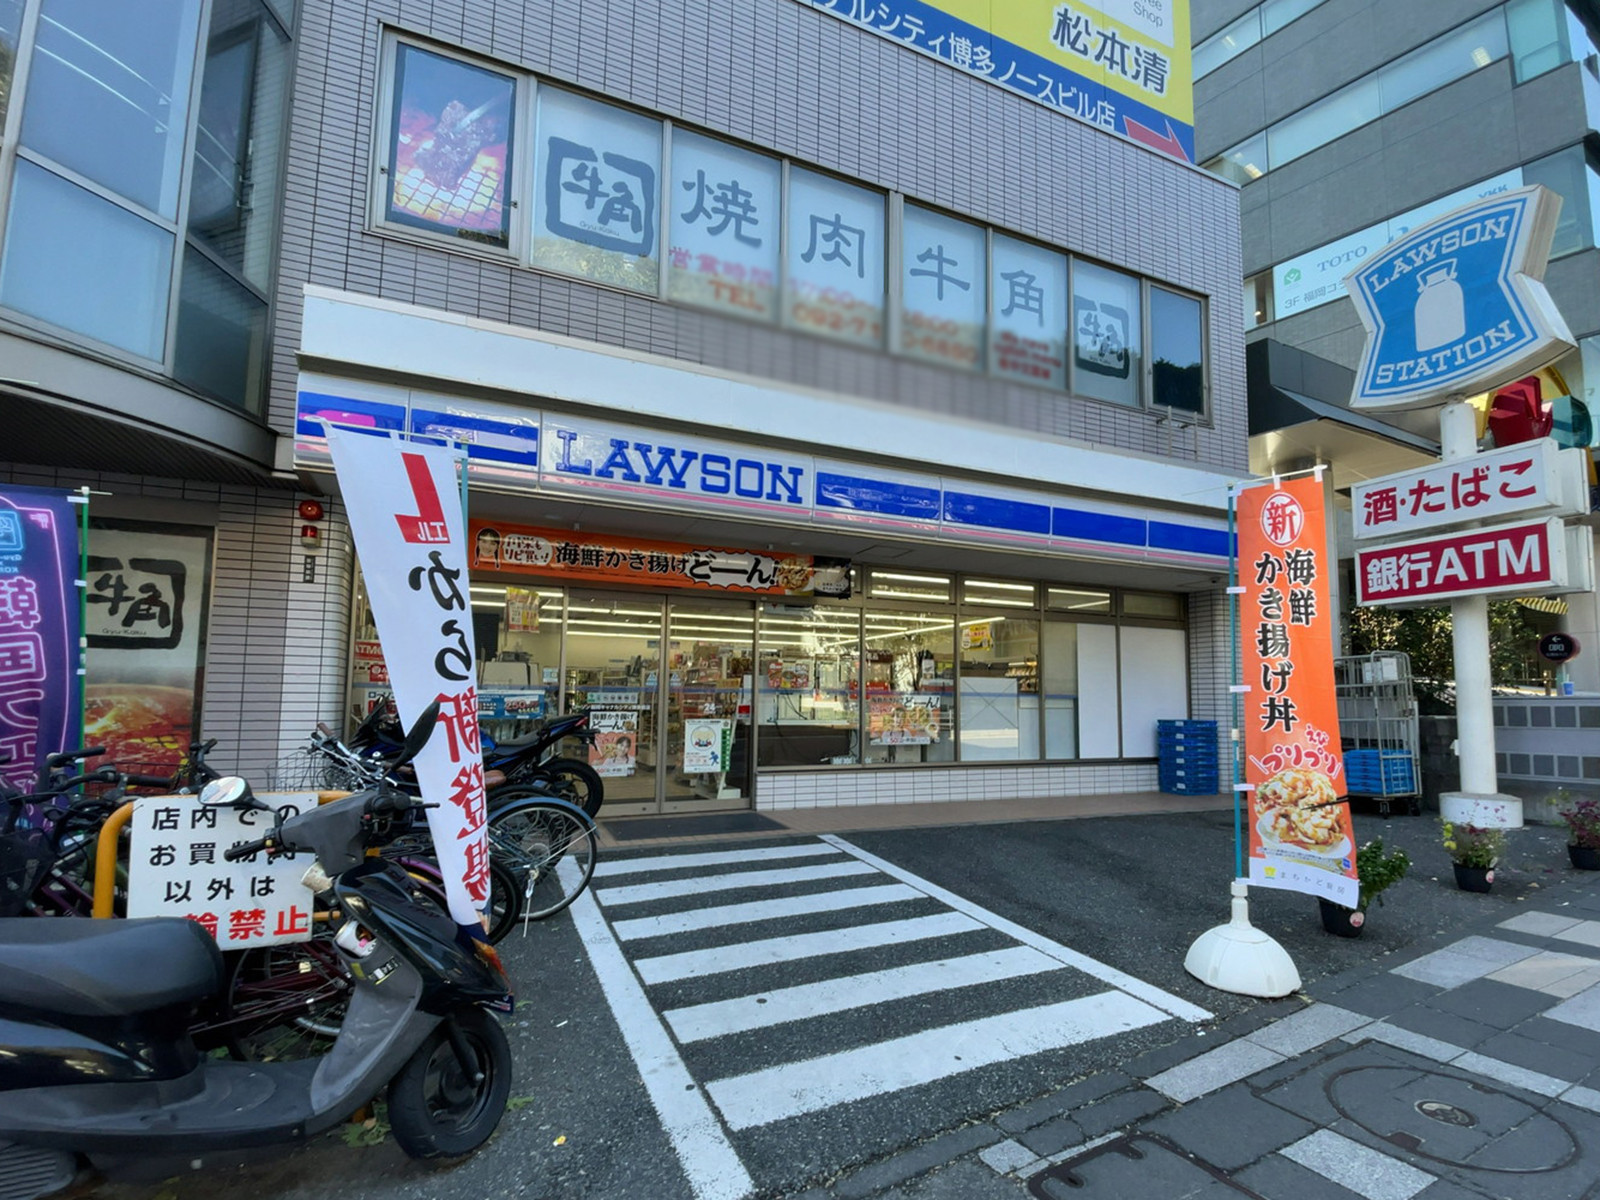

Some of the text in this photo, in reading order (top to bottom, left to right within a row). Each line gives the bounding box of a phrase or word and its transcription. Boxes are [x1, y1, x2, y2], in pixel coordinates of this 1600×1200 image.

[1133, 1, 1164, 28] Shop
[1052, 6, 1168, 95] 松本清
[561, 161, 643, 234] 牛角
[1317, 245, 1368, 273] TOTO
[1369, 214, 1510, 294] LAWSON
[1375, 320, 1517, 385] STATION
[556, 429, 804, 504] LAWSON
[1266, 500, 1298, 541] 新
[1285, 549, 1317, 626] 海鮮
[1366, 534, 1542, 594] 銀行ATM
[86, 573, 172, 629] 牛角
[1255, 552, 1299, 733] かき揚げ丼
[1261, 744, 1337, 775] プリプリ
[163, 875, 276, 904] 以外は
